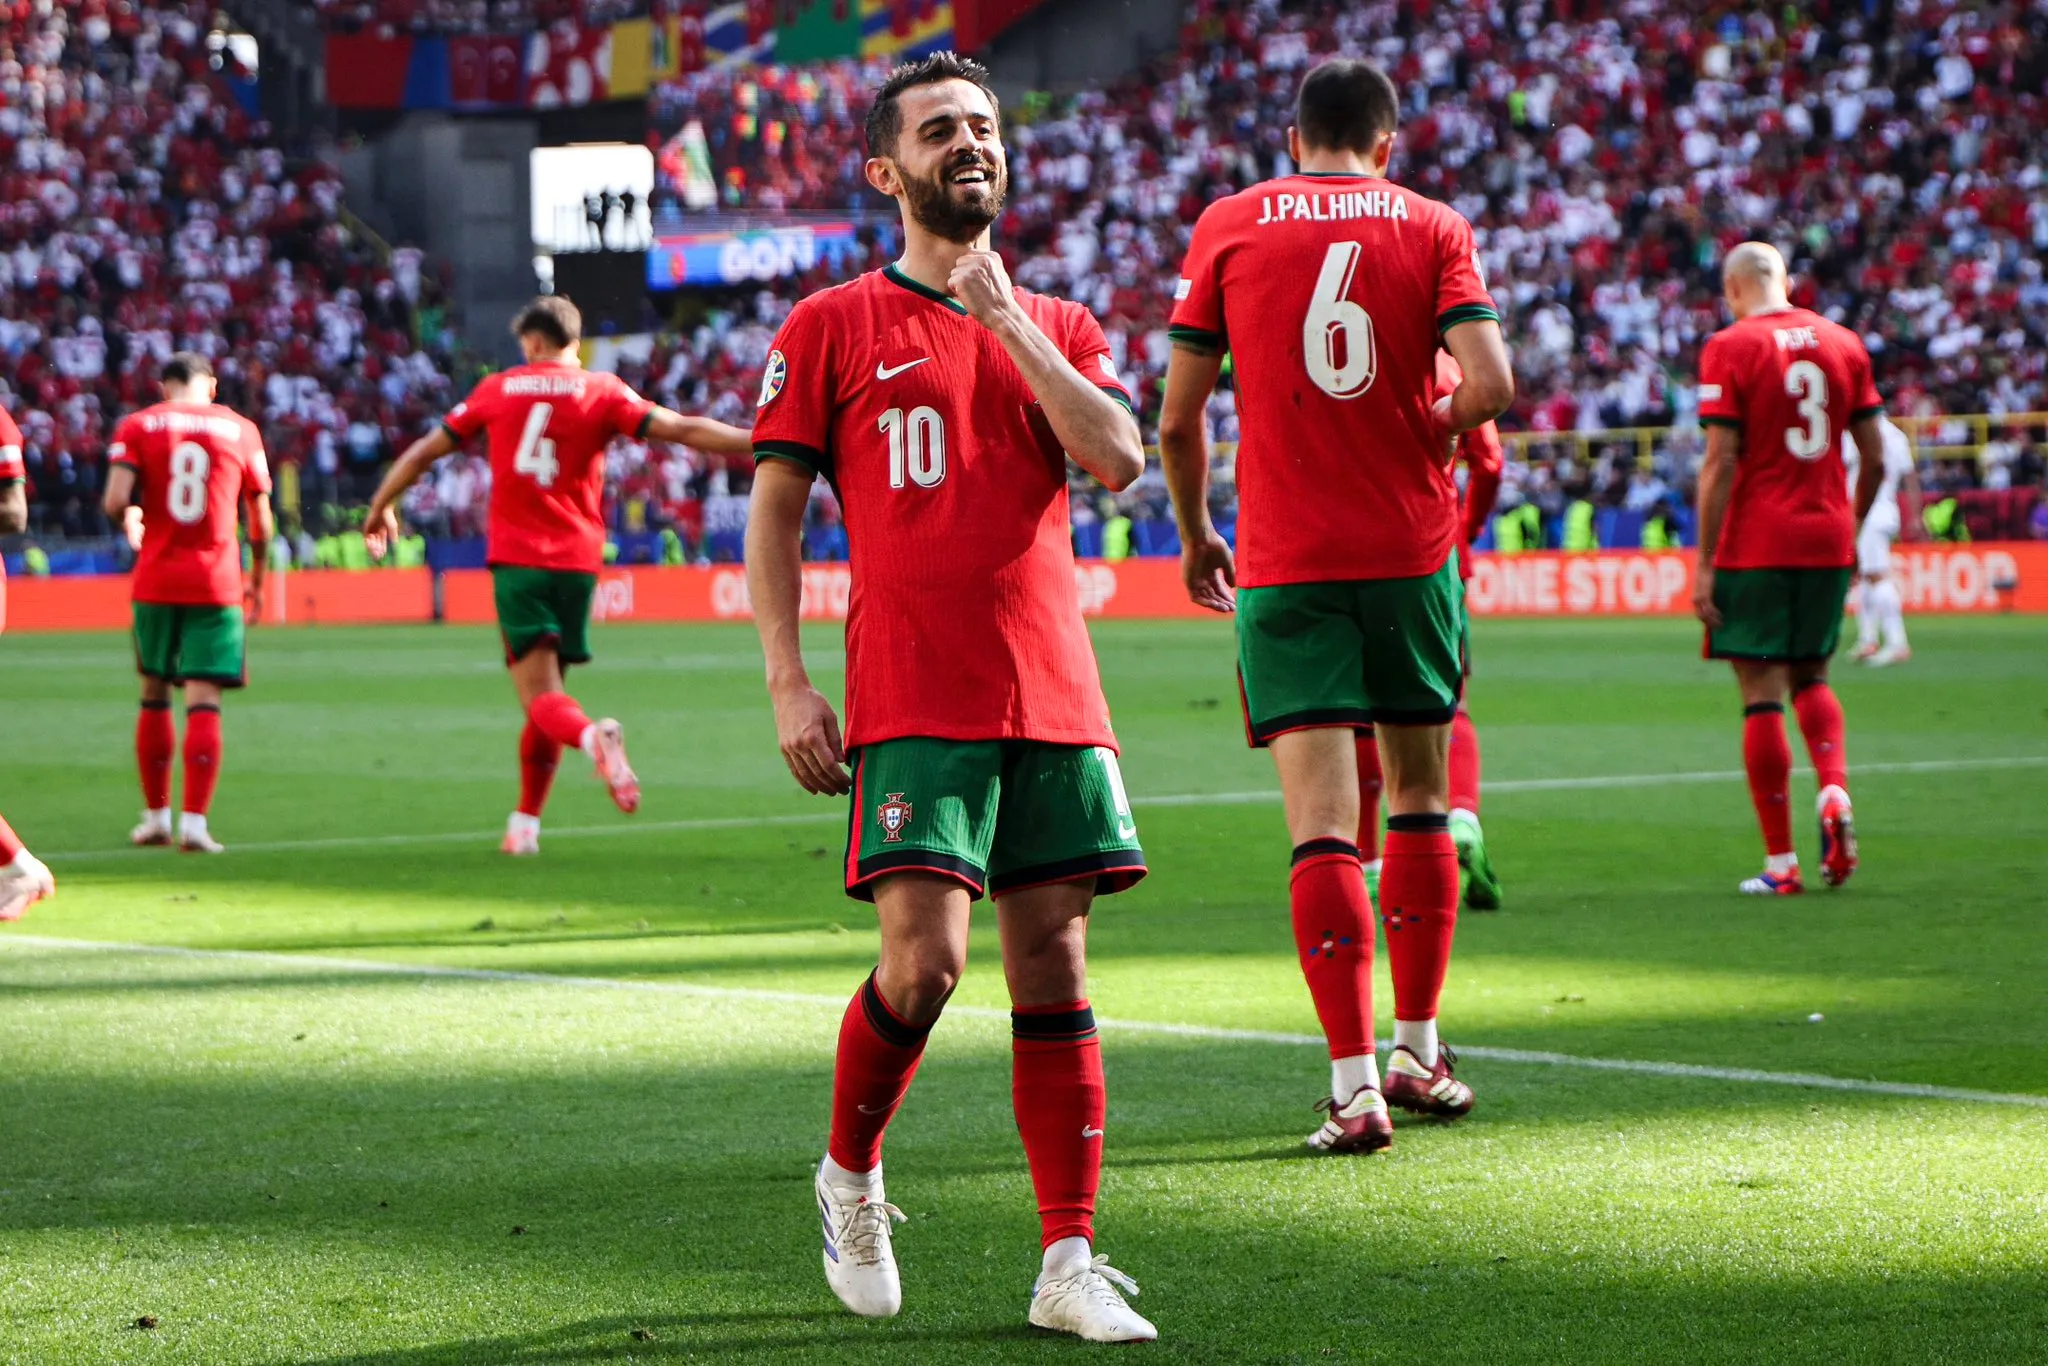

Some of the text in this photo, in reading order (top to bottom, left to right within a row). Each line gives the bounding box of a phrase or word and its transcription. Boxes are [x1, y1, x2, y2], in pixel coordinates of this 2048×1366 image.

[1257, 191, 1409, 225] J.PALHINHA
[1303, 240, 1377, 399] 6
[514, 401, 560, 487] 4
[877, 405, 946, 488] 10
[1784, 360, 1831, 460] 3
[167, 440, 210, 524] 8
[1472, 559, 1559, 613] ONE
[1565, 557, 1685, 612] STOP
